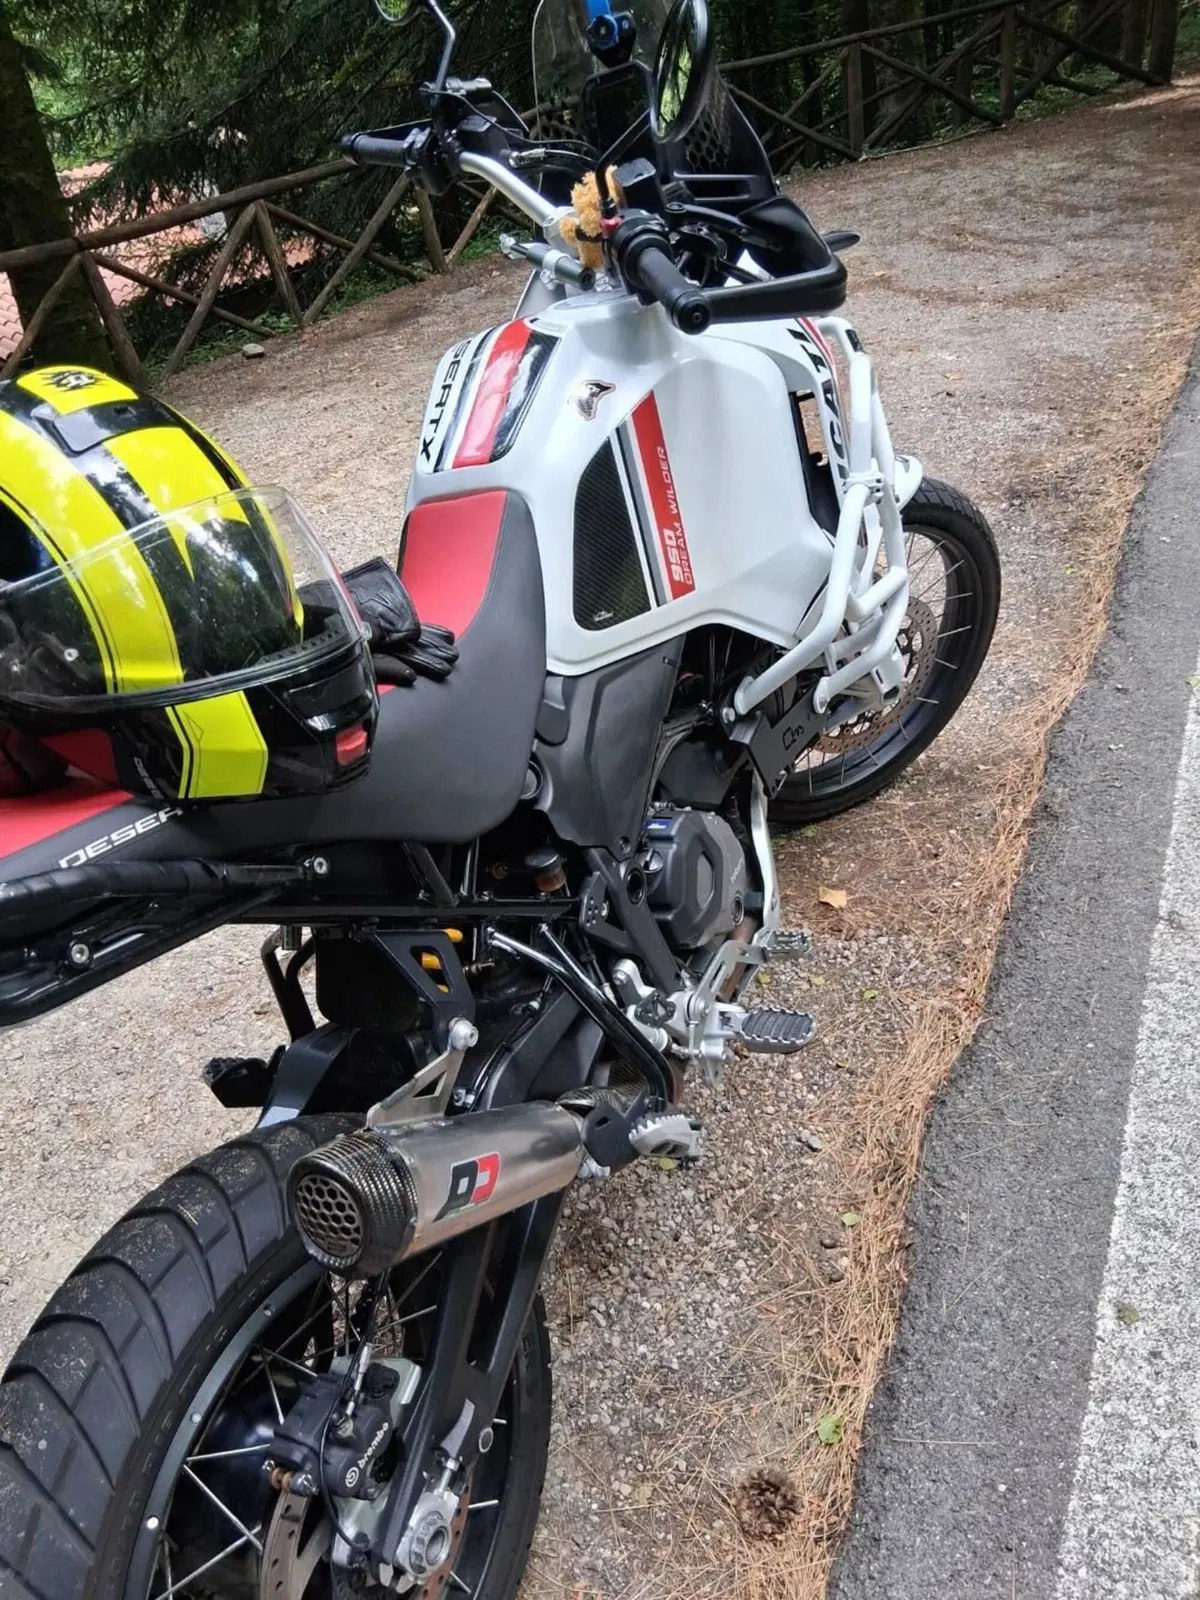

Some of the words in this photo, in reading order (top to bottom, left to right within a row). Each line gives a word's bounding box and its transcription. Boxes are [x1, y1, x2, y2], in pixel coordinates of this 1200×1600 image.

[657, 446, 678, 514] WILDER
[663, 528, 684, 583] 950
[674, 521, 693, 585] DREAM
[357, 1422, 389, 1469] brembo
